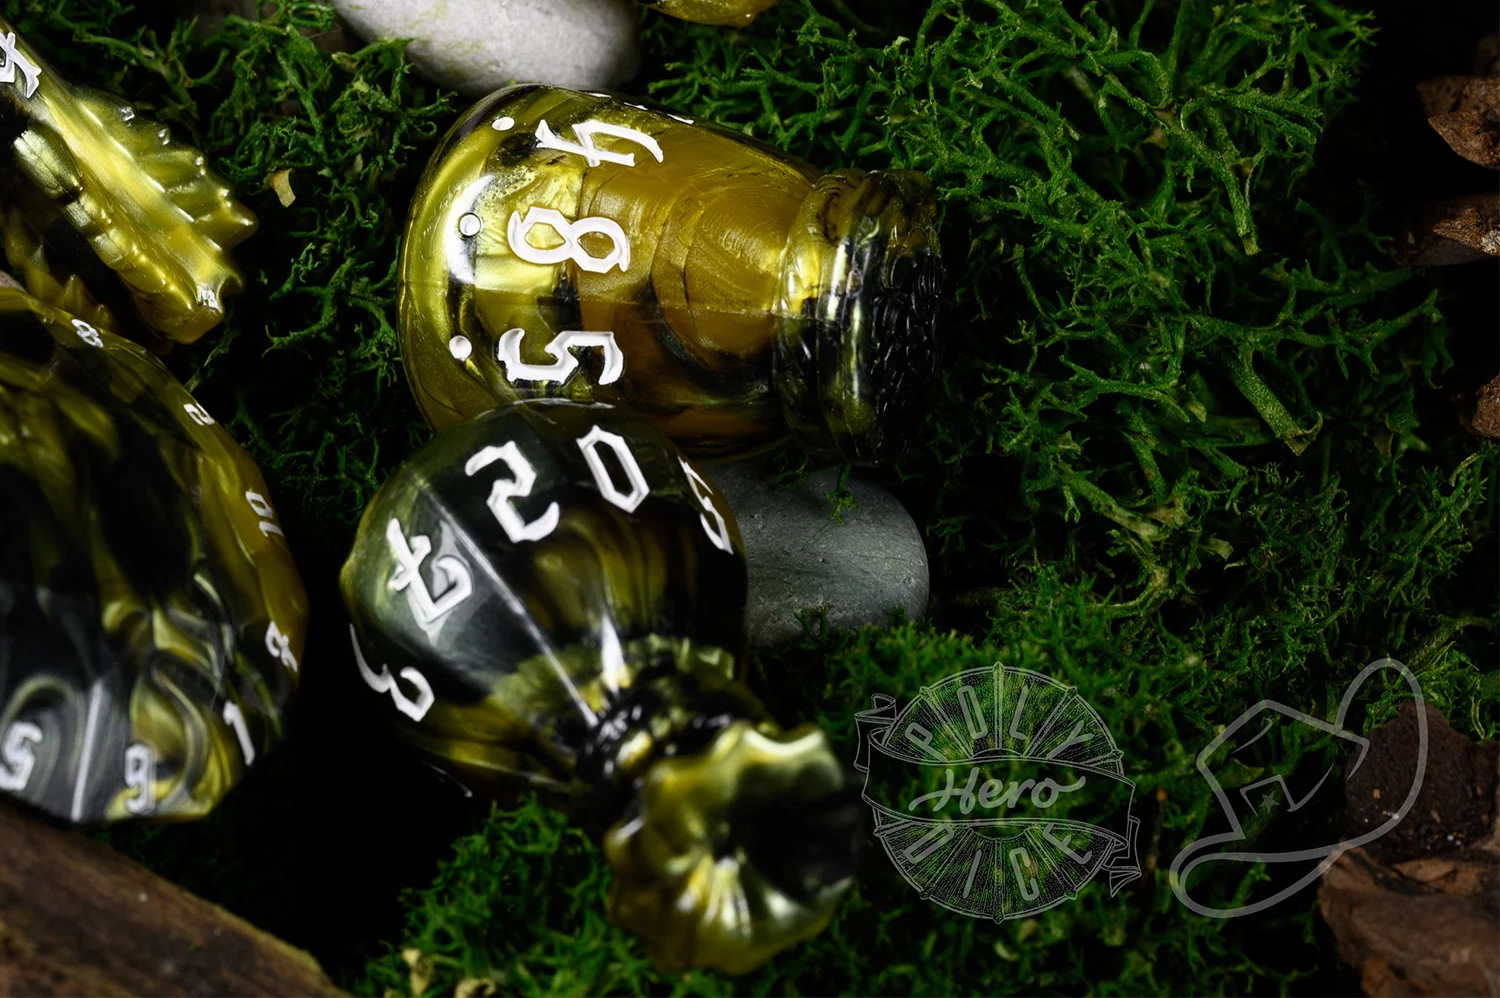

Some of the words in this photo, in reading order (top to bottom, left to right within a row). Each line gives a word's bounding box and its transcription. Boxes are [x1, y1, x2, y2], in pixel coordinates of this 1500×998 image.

[533, 117, 666, 168] 4
[505, 204, 631, 274] 8
[496, 326, 626, 387] 5
[463, 439, 561, 544] 2
[574, 423, 652, 515] 0
[348, 621, 436, 725] 3
[222, 700, 256, 768] 1
